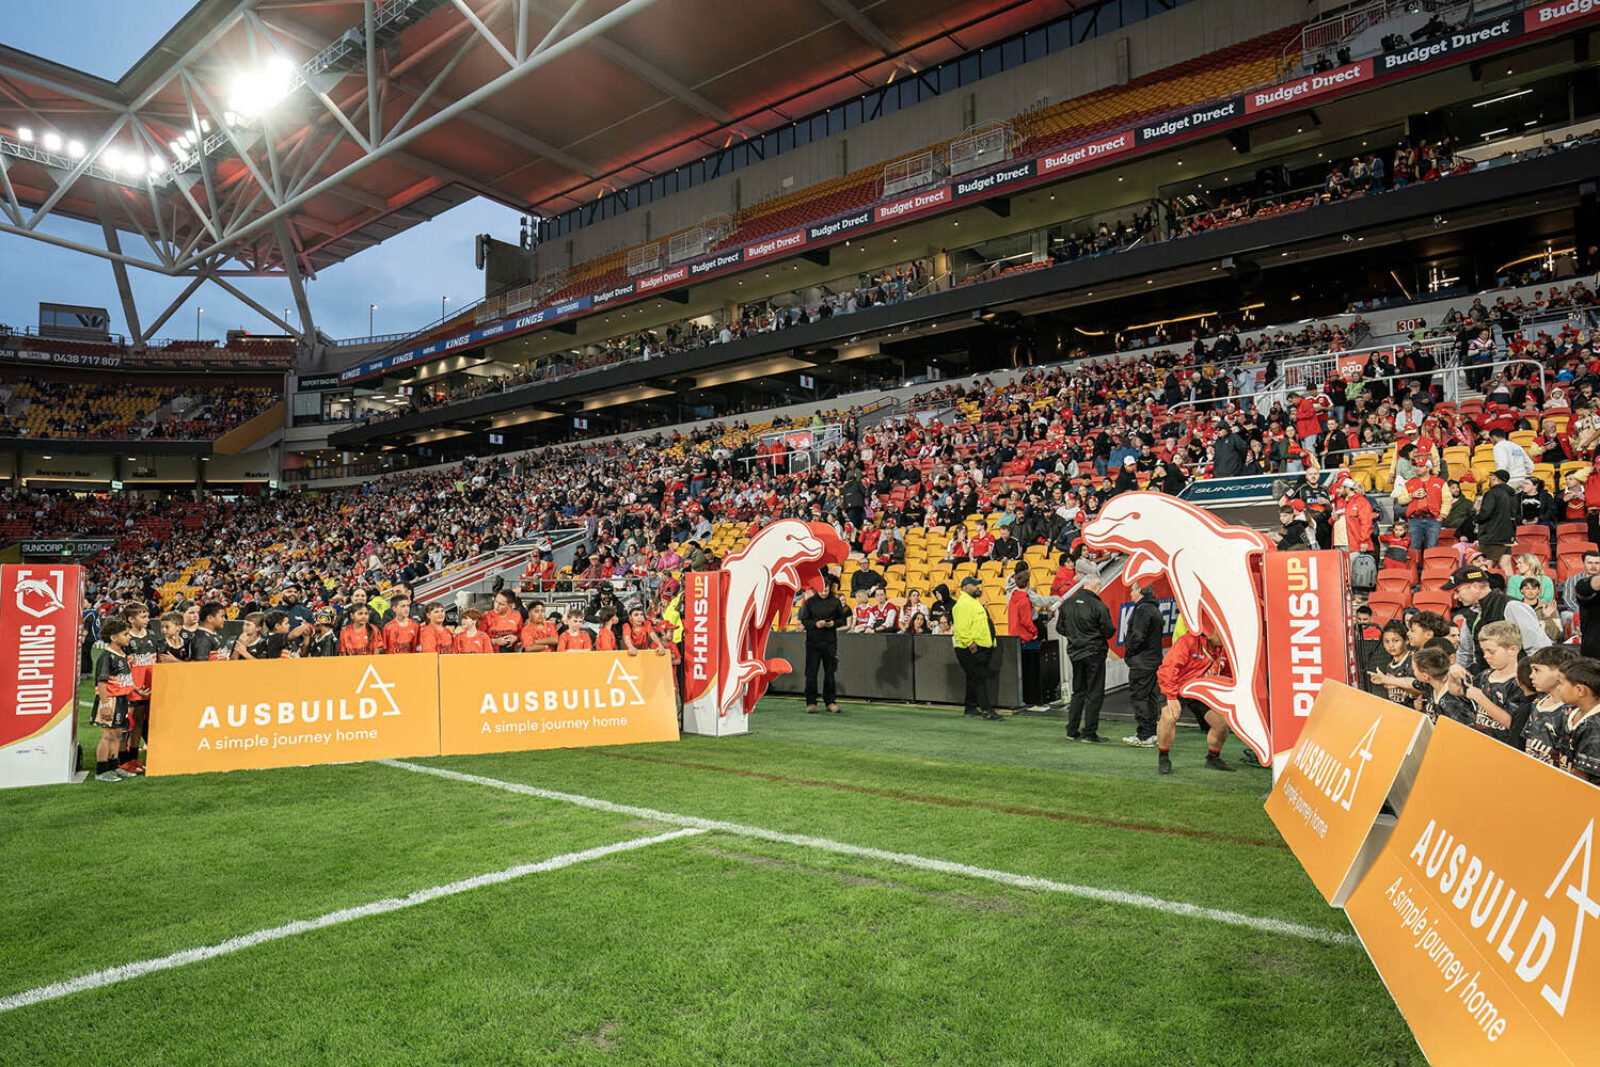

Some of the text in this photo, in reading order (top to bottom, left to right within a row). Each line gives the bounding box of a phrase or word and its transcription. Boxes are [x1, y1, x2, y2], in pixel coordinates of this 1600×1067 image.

[1539, 0, 1600, 22] Budg
[1386, 21, 1509, 68] Budget Direct
[1255, 65, 1360, 106] Budget Direct
[1143, 103, 1234, 140] Budget Direct
[1045, 137, 1124, 169] Budget Direct
[958, 164, 1029, 194] Budget Direct
[881, 191, 944, 216] Budget Direct
[811, 214, 868, 238] Budget Direct
[749, 235, 800, 256] Budget Direct
[692, 253, 739, 273] Budget Direct
[641, 270, 683, 288] Budget Direct
[594, 285, 632, 302] Budget Direct
[515, 312, 544, 329] KINGS
[445, 334, 470, 349] KINGS
[54, 353, 79, 364] 0438
[81, 355, 100, 365] 717
[102, 356, 120, 366] 807
[392, 352, 413, 365] KINGS
[1342, 364, 1362, 374] POD
[22, 543, 63, 552] SUNCORP
[694, 576, 707, 680] PHINS UP
[1287, 557, 1322, 716] PHINS UP
[16, 624, 56, 715] DOLPHINS
[198, 697, 378, 728] AUSBUILD
[480, 688, 626, 714] AUSBUILD
[481, 715, 628, 734] A simple journey home
[198, 728, 378, 750] A simple journey home
[1294, 738, 1350, 802] AUSBUILD
[1284, 783, 1302, 804] simple
[1293, 794, 1314, 826] journey
[1311, 808, 1328, 838] home
[1410, 818, 1556, 982] AUSBUILD
[1385, 876, 1506, 1042] A simple journey home
